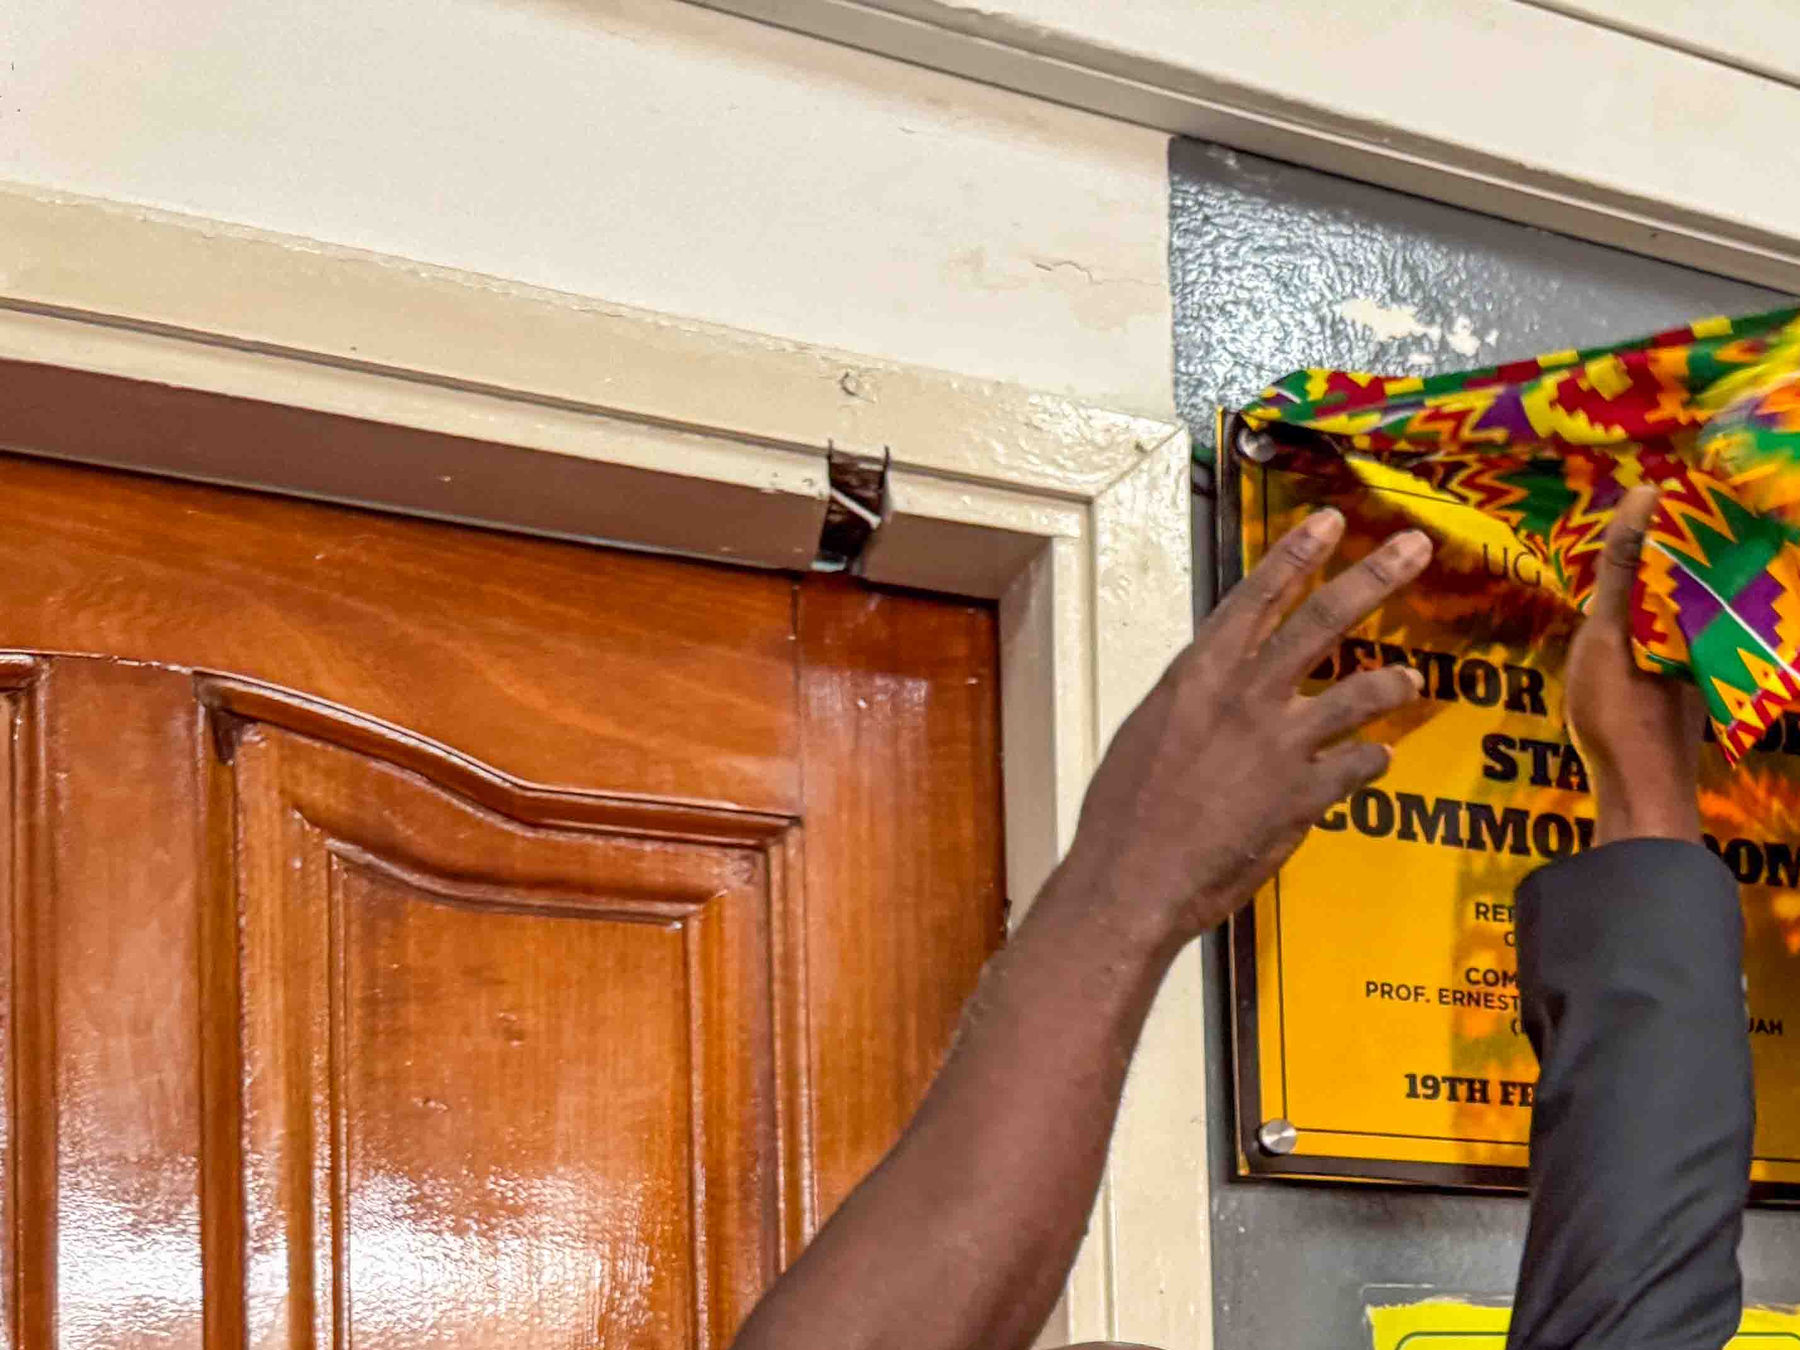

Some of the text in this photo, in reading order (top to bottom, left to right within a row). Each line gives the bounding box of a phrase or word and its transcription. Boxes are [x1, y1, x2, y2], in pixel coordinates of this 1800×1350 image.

[1482, 733, 1592, 793] STA
[1365, 980, 1520, 1011] PROF. ERNEST
[1404, 1073, 1490, 1105] 19TH
